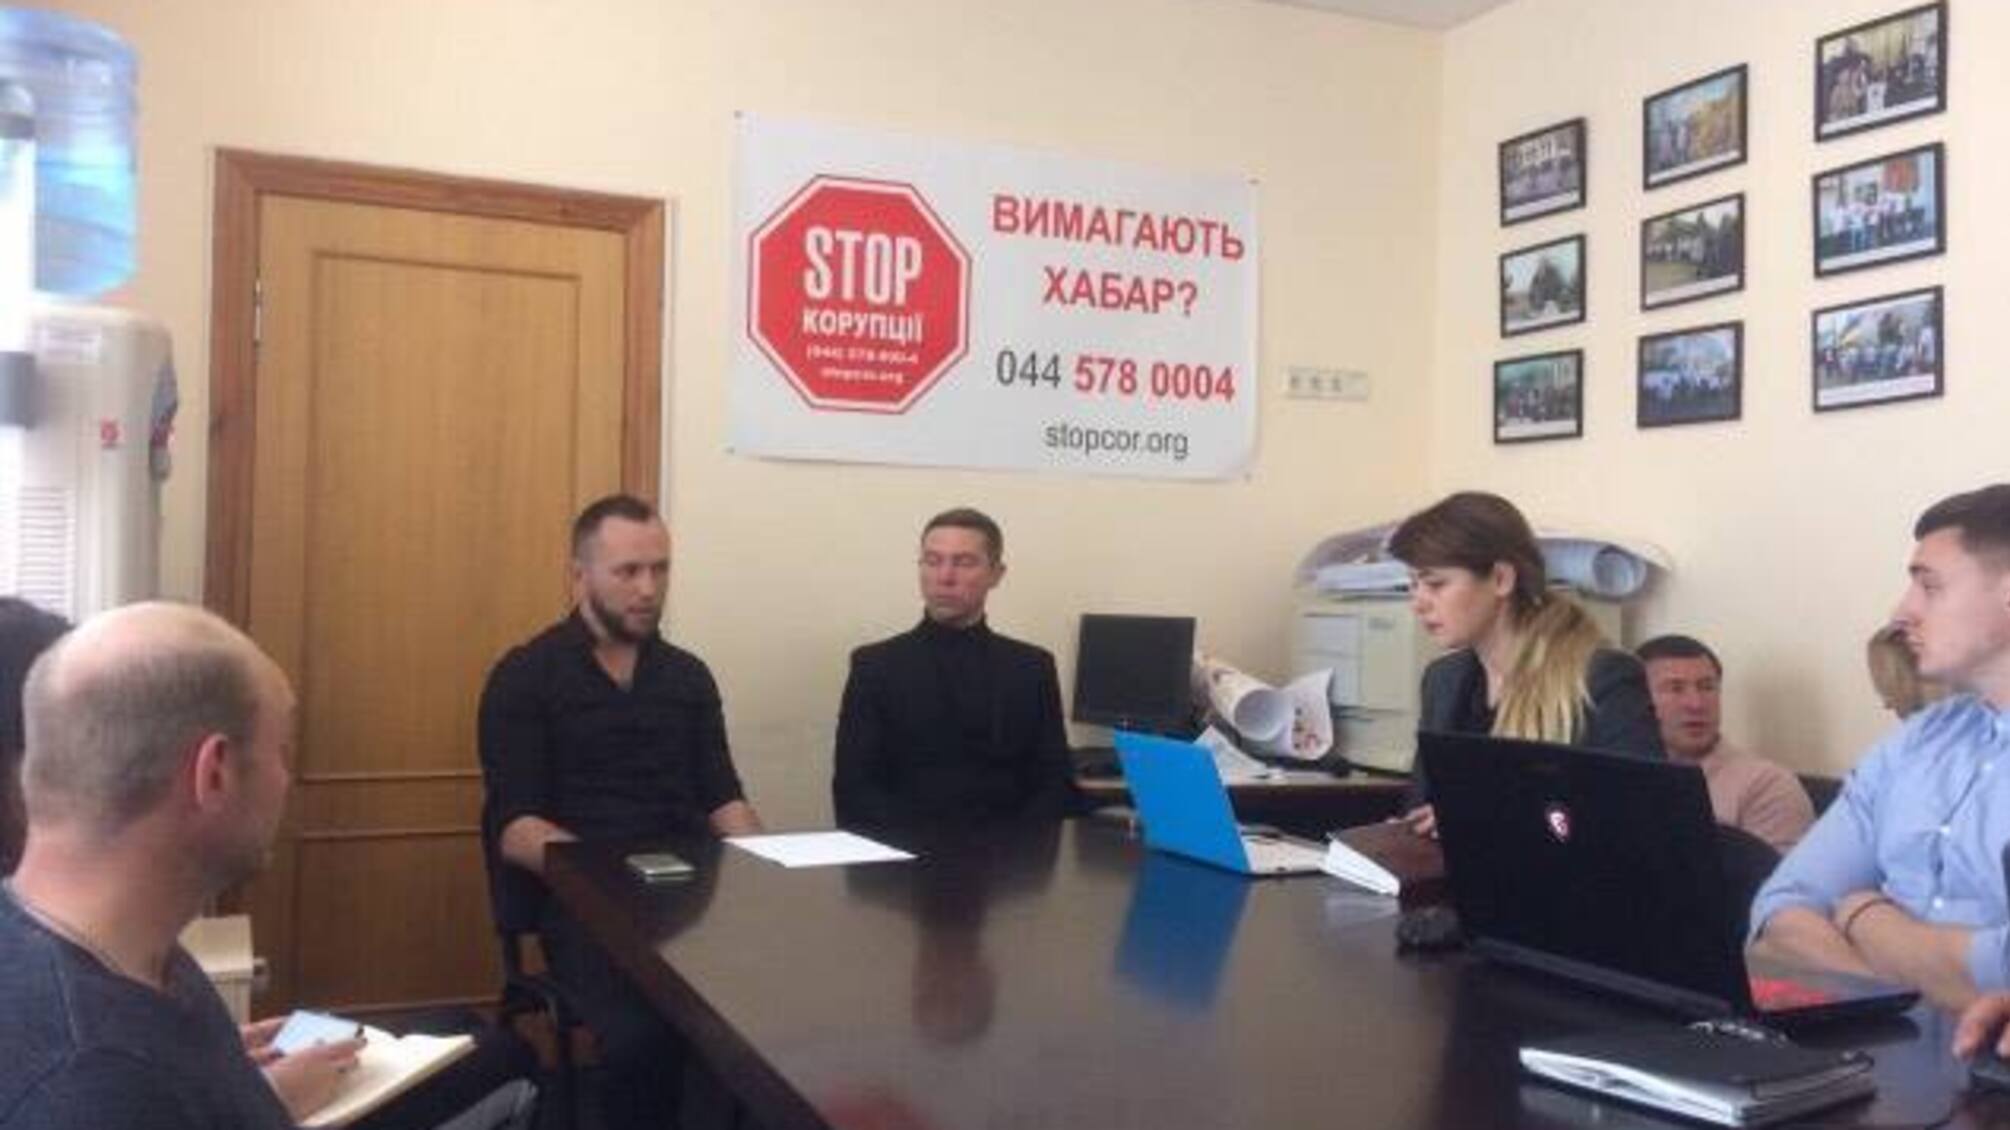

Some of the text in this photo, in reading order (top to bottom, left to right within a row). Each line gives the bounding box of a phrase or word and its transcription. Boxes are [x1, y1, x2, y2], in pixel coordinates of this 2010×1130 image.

[993, 195, 1245, 261] ВИМАГАЮТЬ
[804, 226, 922, 306] STOP
[1042, 265, 1198, 318] ХАБАР?
[802, 308, 922, 347] КОРУПЦІЇ
[996, 349, 1236, 403] 044 578 0004
[1044, 424, 1190, 461] stopcor.org
